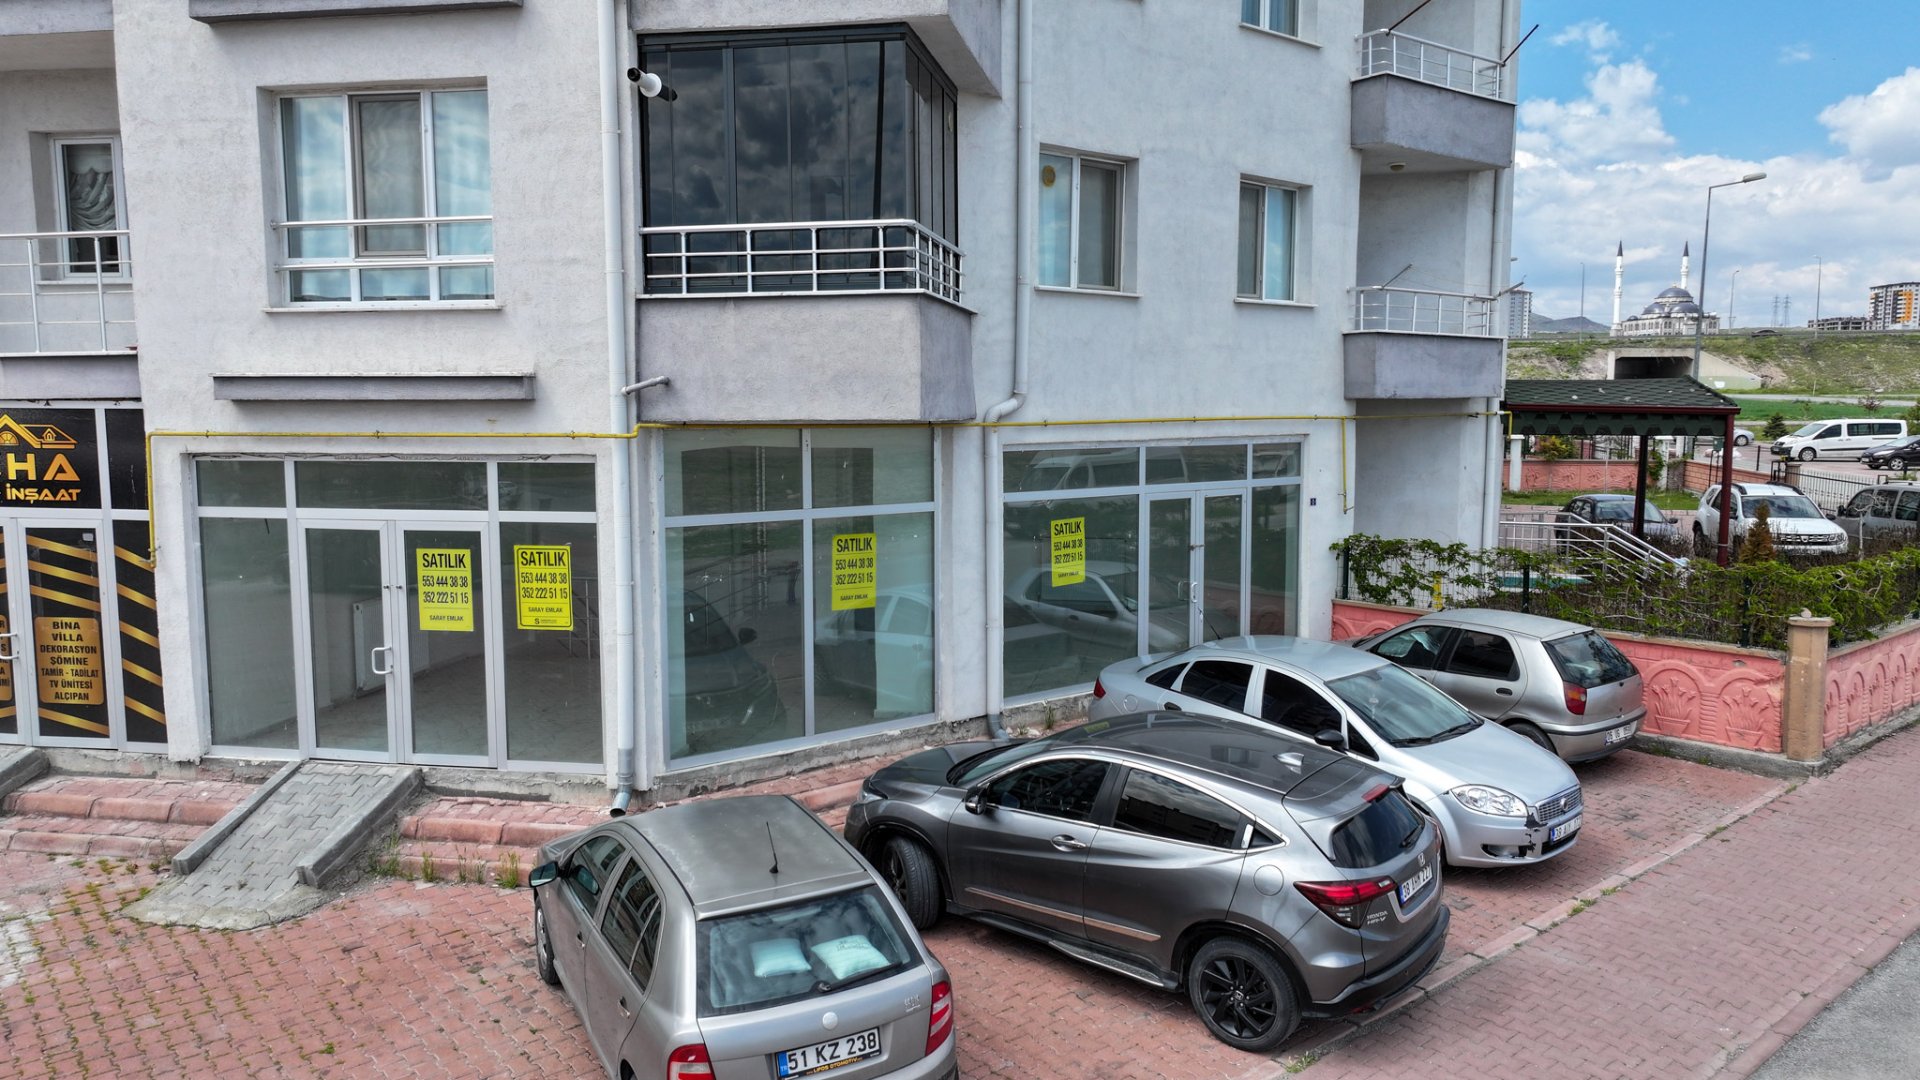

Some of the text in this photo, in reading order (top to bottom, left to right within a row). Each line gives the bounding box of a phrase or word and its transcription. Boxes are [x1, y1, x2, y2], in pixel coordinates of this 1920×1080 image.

[6, 483, 81, 504] İNŞAAT
[1054, 521, 1082, 536] SATILIK
[836, 537, 872, 552] SATILIK
[422, 553, 466, 568] SATILIK
[520, 550, 566, 566] SATILIK
[836, 557, 874, 570] 553 444 38 38
[422, 575, 468, 588] 553 444 38 38
[521, 572, 567, 584] 553 444 38 38
[836, 572, 874, 585] 352 222 51 15
[423, 591, 468, 604] 352 222 51 15
[522, 587, 568, 599] 352 222 51 15
[52, 620, 80, 630] BİNA
[52, 633, 84, 642] VİLLA
[40, 644, 97, 654] DEKORASYON
[50, 656, 89, 666] ŞÖMİNE
[41, 667, 64, 676] TAMİR
[70, 668, 99, 678] TADİLAT
[50, 679, 92, 689] TV ÜNİTESİ
[54, 692, 89, 701] ALÇIPAN
[1366, 910, 1388, 920] HONDA
[788, 1050, 807, 1070] 51
[815, 1042, 840, 1063] KZ
[846, 1032, 876, 1055] 238
